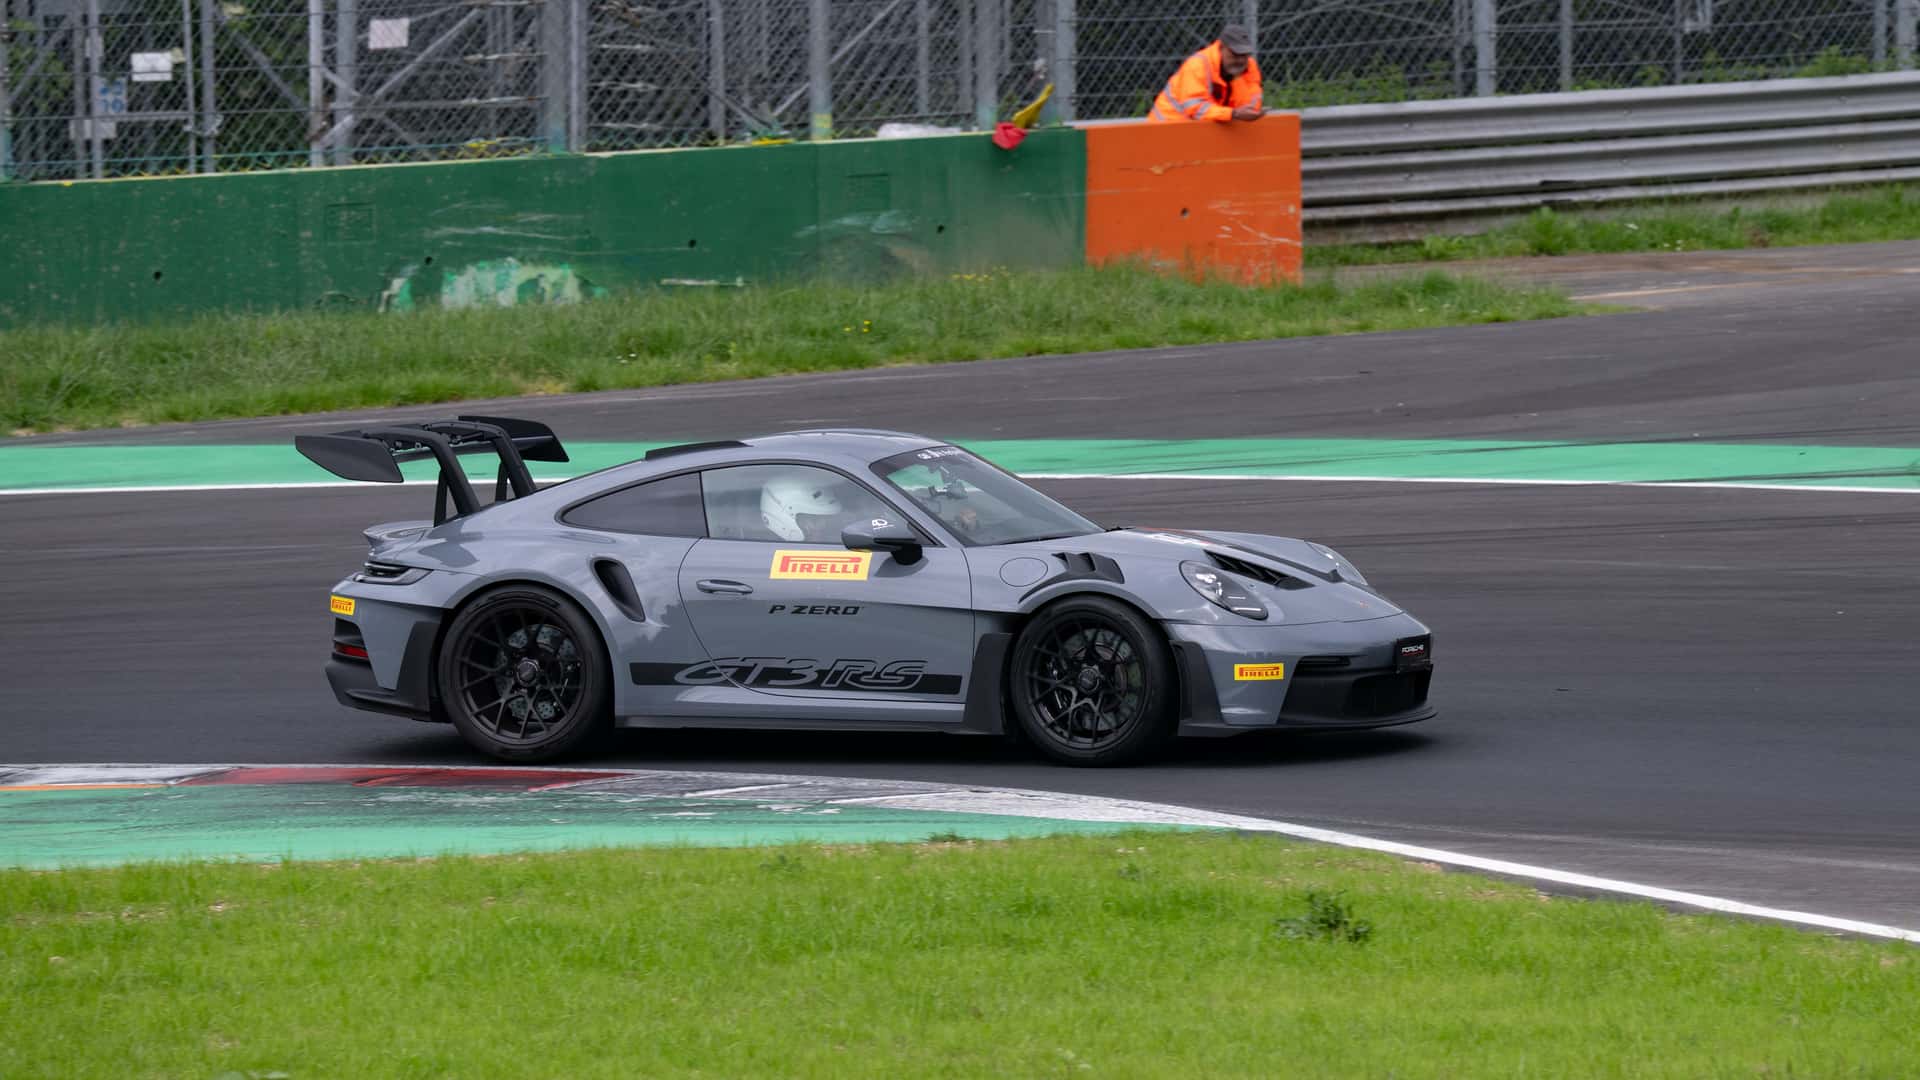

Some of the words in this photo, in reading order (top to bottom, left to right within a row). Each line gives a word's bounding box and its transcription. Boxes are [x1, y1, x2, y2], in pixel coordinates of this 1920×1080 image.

[779, 556, 862, 574] PIRELLI
[768, 604, 786, 615] P
[791, 605, 860, 616] ZERO
[1238, 666, 1280, 677] PIRELLI
